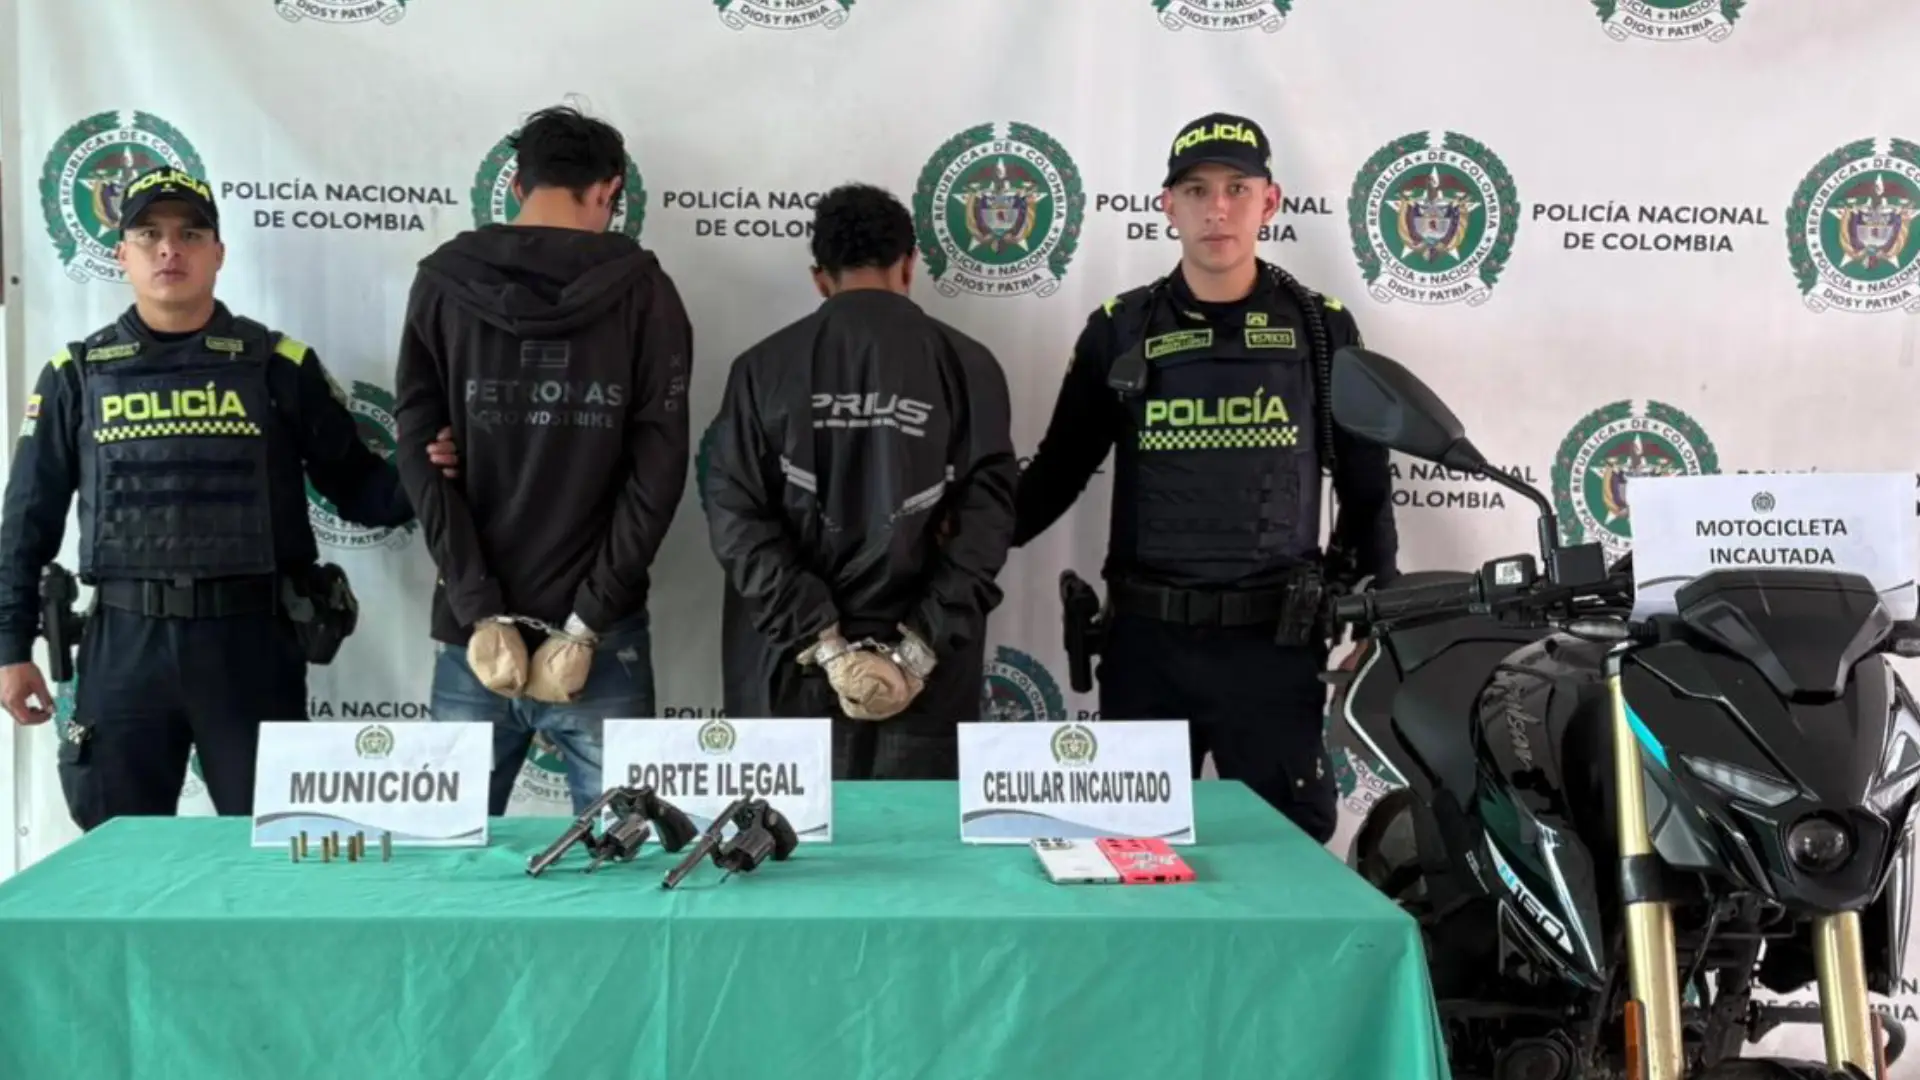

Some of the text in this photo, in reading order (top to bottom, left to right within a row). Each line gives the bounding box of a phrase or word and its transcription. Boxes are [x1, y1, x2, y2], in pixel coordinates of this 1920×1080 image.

[740, 4, 771, 24] DIOS
[785, 5, 831, 24] PATRIA
[1179, 5, 1209, 25] DIOS
[1223, 8, 1267, 26] PATRIA
[1623, 15, 1654, 36] DIOS
[1667, 17, 1714, 37] PATRIA
[1174, 121, 1258, 156] POLICÍA
[62, 137, 106, 206] REPUBLICA
[119, 131, 137, 141] DE
[934, 142, 1065, 221] REPUBLICA DE COLOMBIA
[221, 178, 458, 205] POLICÍA NACIONAL
[663, 186, 761, 209] POLICÍA
[1096, 194, 1165, 213] POLIC
[1368, 151, 1498, 230] REPUBLICA DE COLOMBIA
[1808, 166, 1859, 235] REPUBLICA
[1873, 158, 1893, 169] DE
[253, 210, 425, 231] DE COLOMBIA
[1532, 200, 1769, 225] POLICÍA NACIONAL
[695, 219, 727, 236] DE
[1127, 223, 1158, 240] DE
[1563, 231, 1734, 252] DE COLOMBIA
[940, 235, 1059, 275] POLICIA NACIONAL
[1375, 242, 1490, 284] POLICIA NACIONAL
[84, 259, 115, 278] DIOS
[1814, 251, 1853, 289] POLICIA
[953, 272, 984, 291] DIOS
[997, 272, 1041, 292] PATRIA
[1388, 280, 1417, 299] DIOS
[1429, 283, 1474, 301] PATRIA
[1823, 287, 1854, 307] DIOS
[1865, 290, 1911, 308] PATRIA
[101, 380, 247, 425] POLICÍA
[465, 379, 623, 406] PETRONAS
[811, 391, 934, 425] PRIUS
[1145, 386, 1290, 427] POLICÍA
[1572, 424, 1617, 493] REPUBLICA
[1631, 419, 1649, 430] DE
[1391, 490, 1506, 510] OLOMBIA
[1696, 518, 1847, 537] MOTOCICLETA
[1710, 547, 1835, 565] INCAUTADA
[290, 762, 460, 804] MUNICIÓN
[628, 763, 805, 796] PORTE ILEGAL
[983, 771, 1171, 803] CELULAR INCAUTADO
